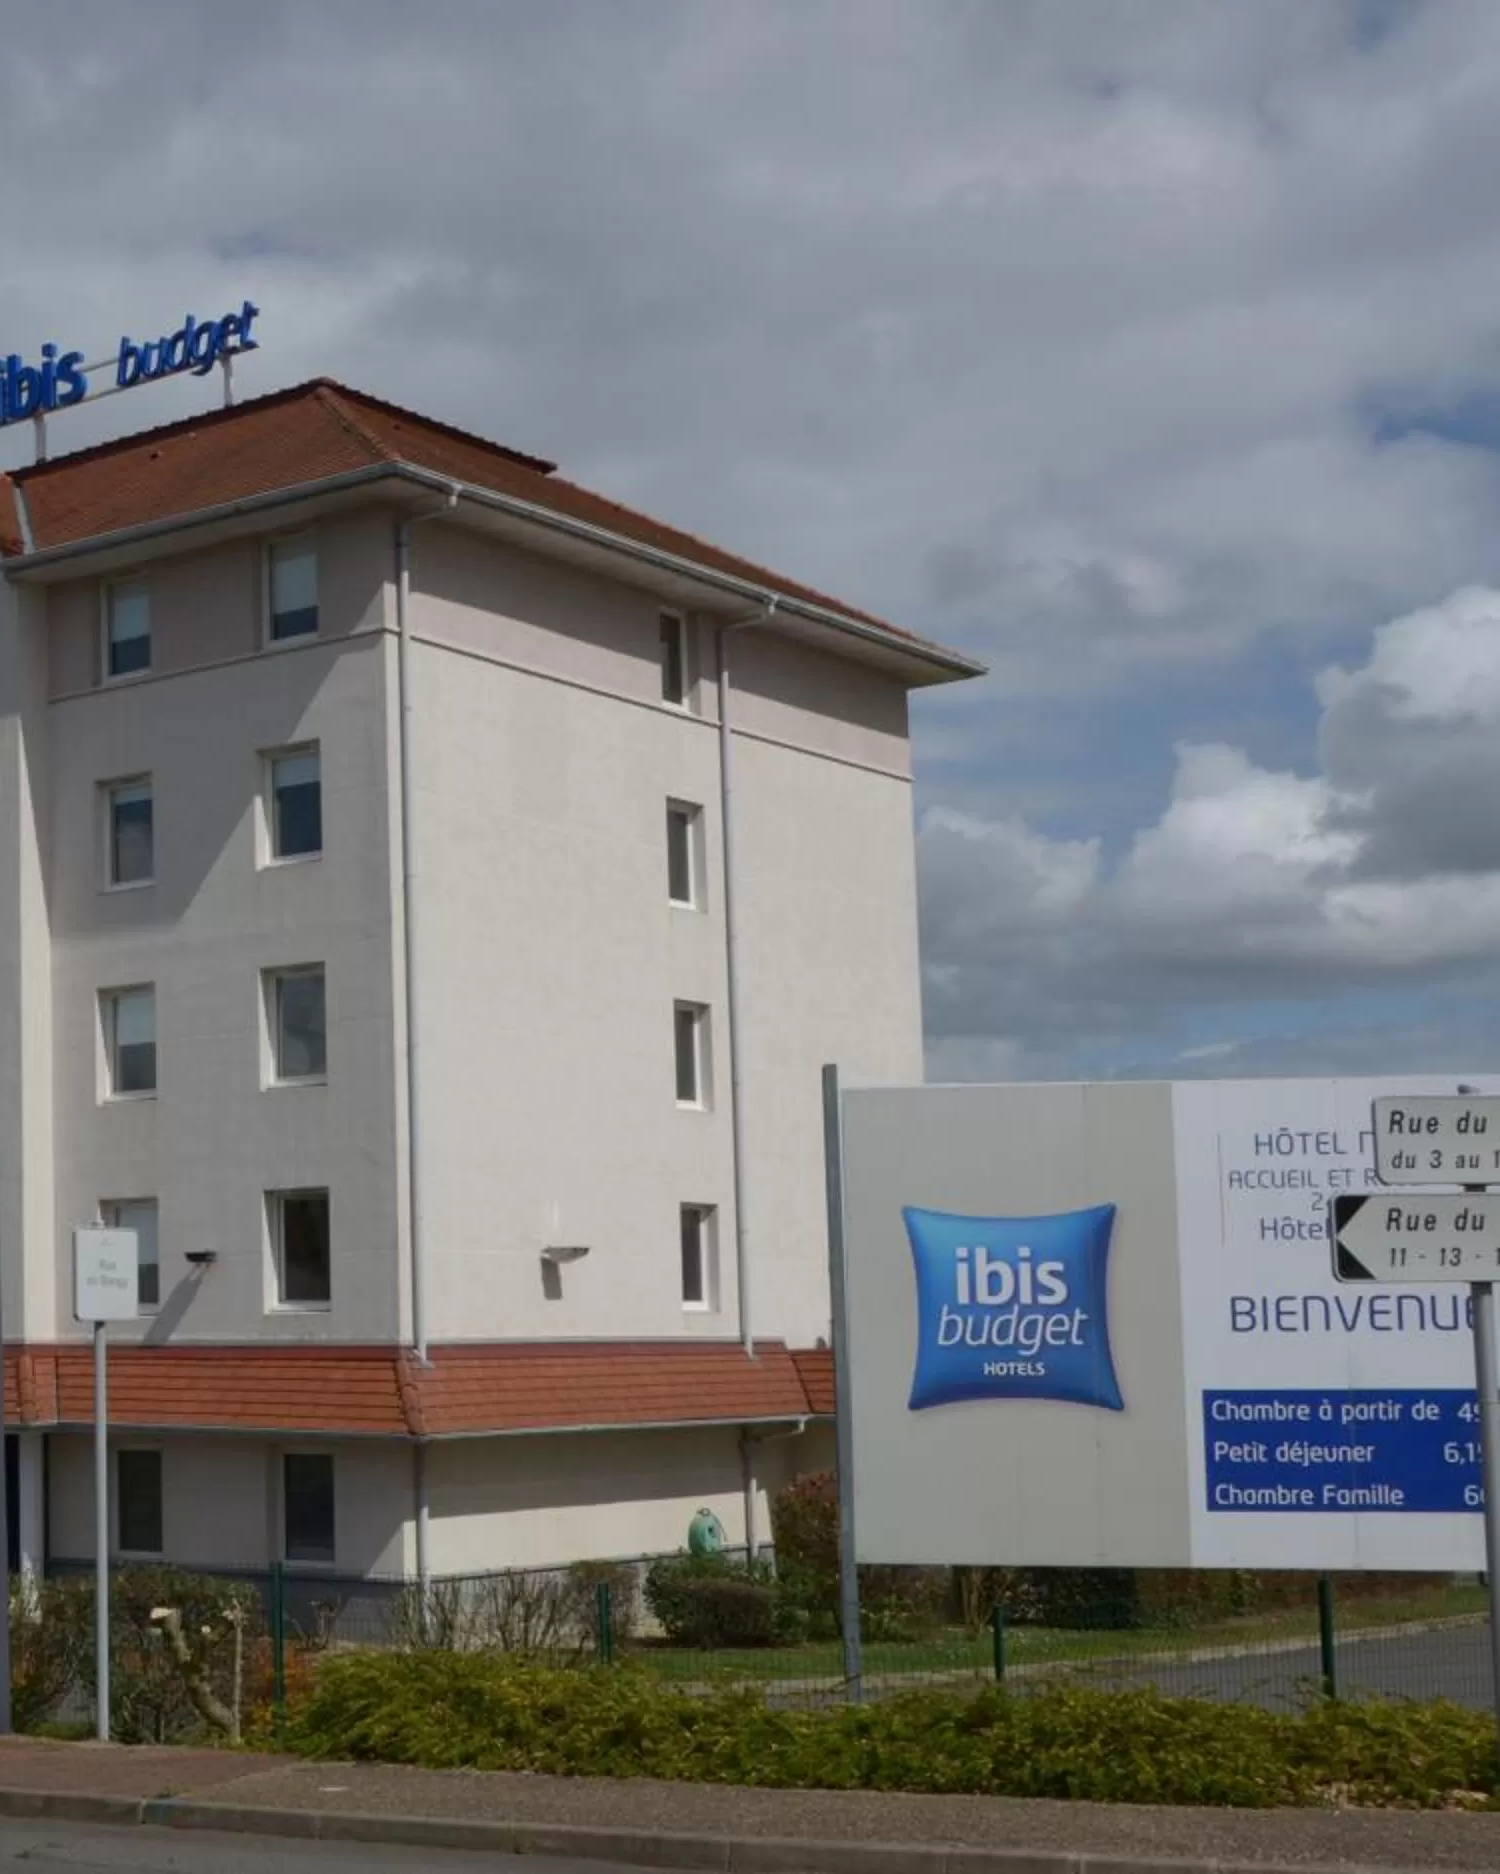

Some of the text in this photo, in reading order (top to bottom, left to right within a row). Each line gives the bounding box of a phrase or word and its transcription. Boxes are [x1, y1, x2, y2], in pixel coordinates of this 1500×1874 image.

[117, 301, 259, 388] budget
[1389, 1109, 1488, 1135] Rue du
[1254, 1127, 1348, 1156] HÔTEL
[1391, 1149, 1417, 1169] du
[1429, 1149, 1443, 1169] 3
[1455, 1153, 1480, 1169] au
[1228, 1169, 1319, 1190] ACCUEIL
[1328, 1168, 1355, 1187] ET
[1385, 1206, 1485, 1232] Rue du
[1390, 1247, 1407, 1267] 11
[1440, 1247, 1462, 1267] 13
[954, 1246, 1068, 1306] ibis
[937, 1303, 1089, 1356] budget
[983, 1362, 1046, 1377] HOTELS
[1211, 1399, 1311, 1421] Chambre
[1319, 1399, 1333, 1421] à
[1341, 1400, 1402, 1424] partir
[1411, 1400, 1441, 1421] de
[1213, 1441, 1268, 1463] Petit
[1275, 1441, 1376, 1467] déjeuner
[1215, 1484, 1315, 1506] Chambre
[1323, 1484, 1405, 1506] Famille
